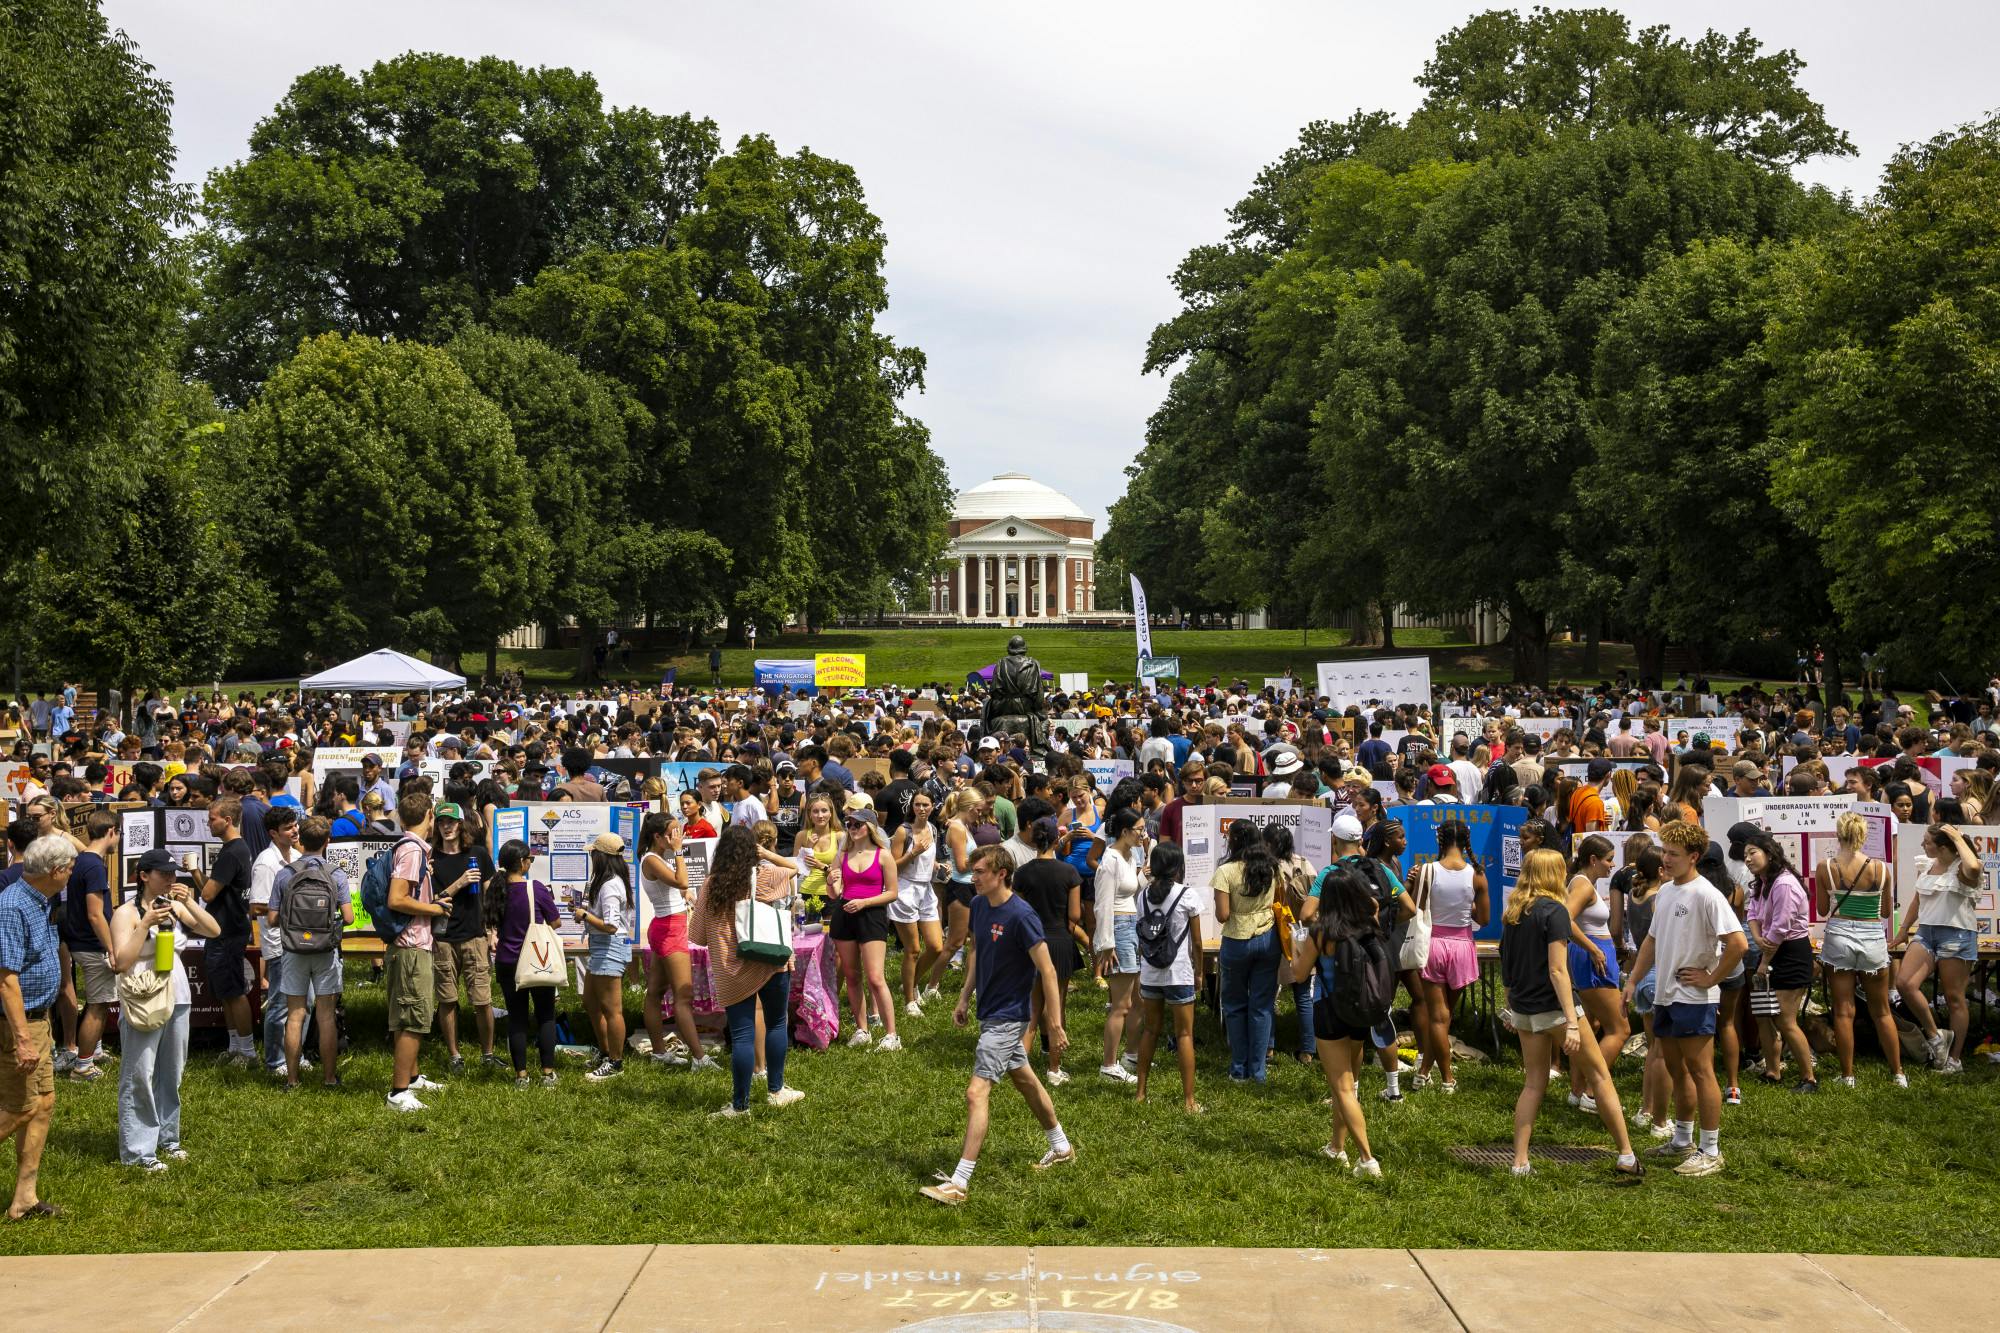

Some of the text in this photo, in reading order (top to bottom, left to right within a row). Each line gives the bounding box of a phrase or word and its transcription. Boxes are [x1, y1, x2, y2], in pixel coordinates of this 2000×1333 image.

[816, 666, 864, 678] INTERNATIONAL
[824, 674, 858, 683] STUDENTS
[1453, 718, 1482, 727] GREEN
[1096, 775, 1112, 785] club
[562, 809, 582, 819] ACS
[1249, 814, 1300, 827] THE COURSE
[814, 1263, 1202, 1291] sign-ups inside!
